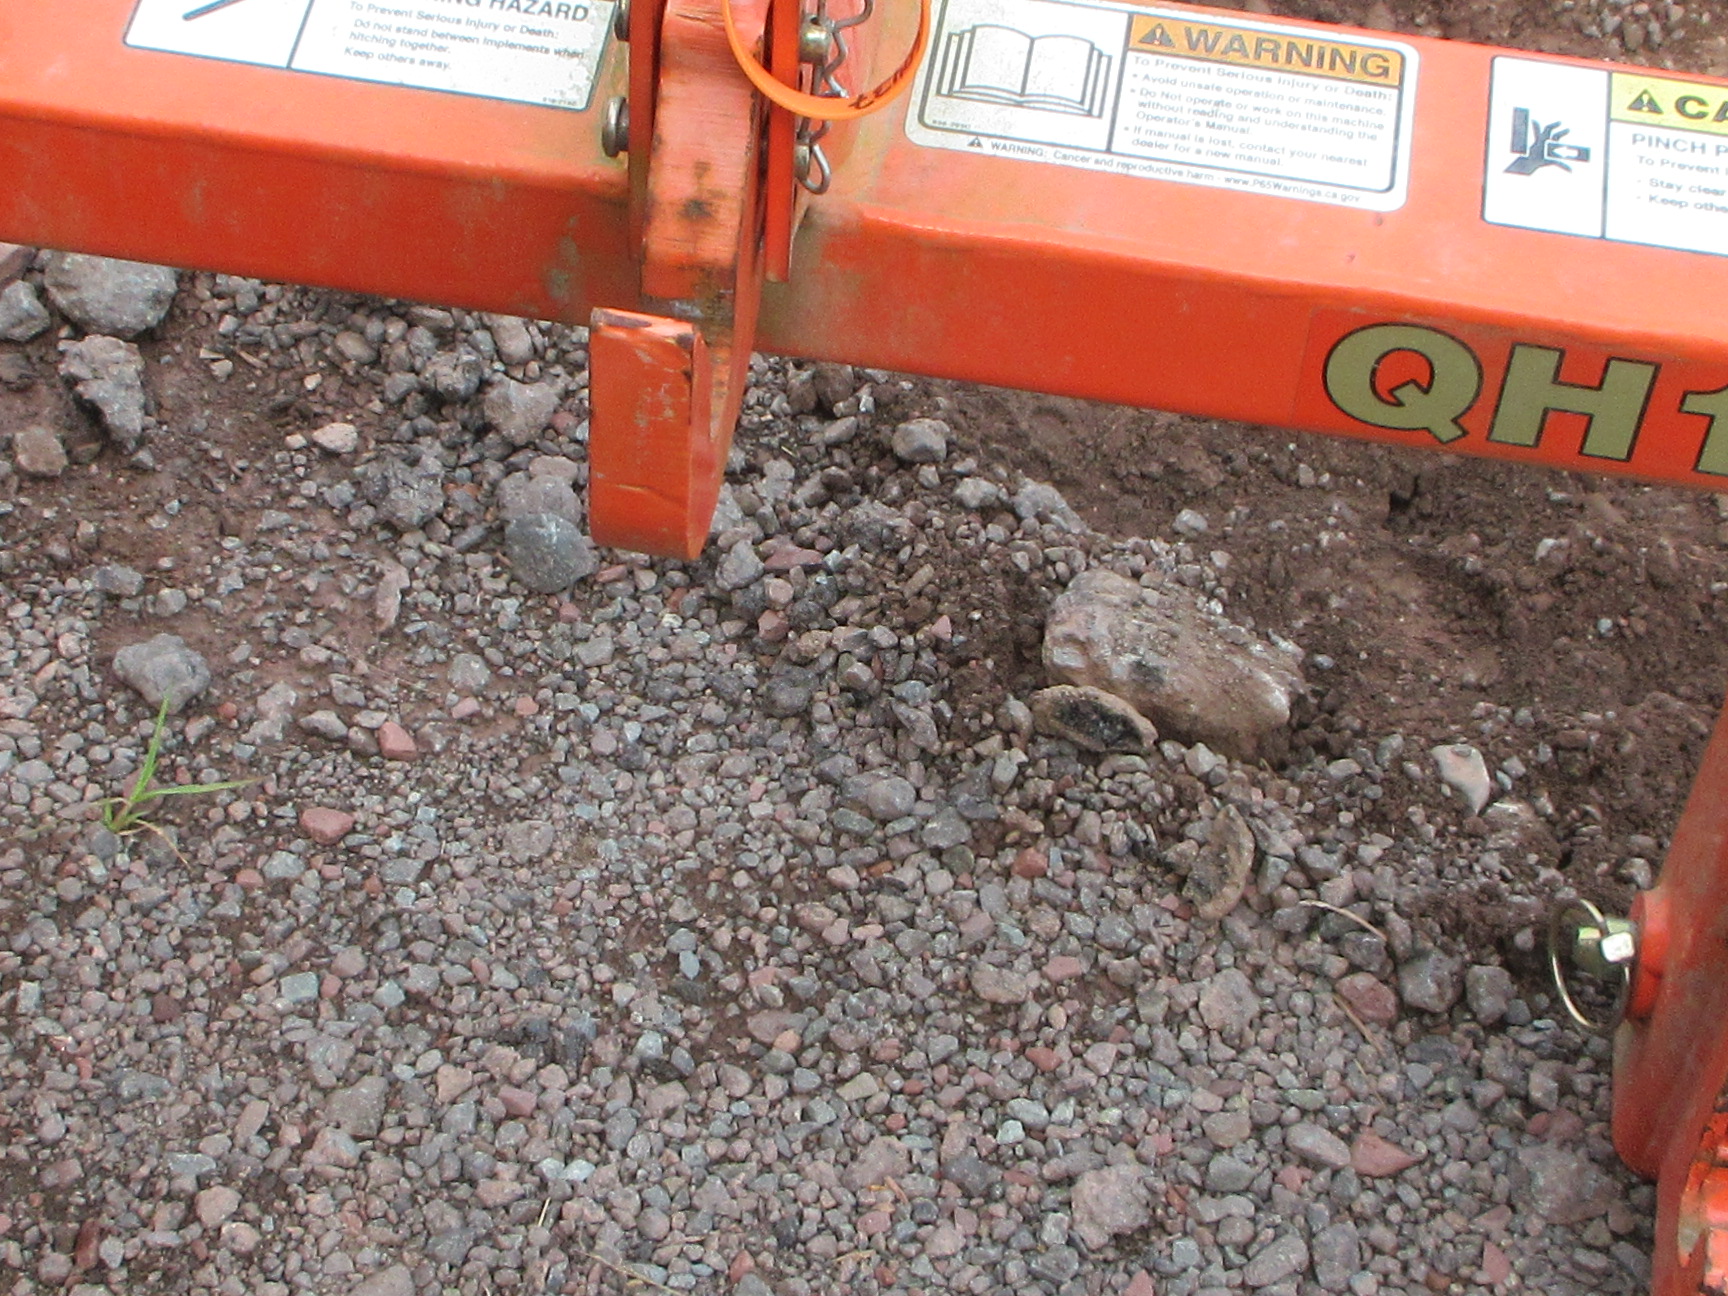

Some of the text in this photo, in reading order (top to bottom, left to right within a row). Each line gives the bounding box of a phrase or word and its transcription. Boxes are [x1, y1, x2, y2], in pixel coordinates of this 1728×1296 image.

[350, 0, 560, 39] To Prevent Serious Injury or Death:
[354, 18, 370, 28] Do
[373, 22, 392, 32] not
[395, 25, 428, 38] stand
[431, 29, 479, 45] between
[554, 46, 585, 59] when
[344, 46, 452, 71] Keep others away.
[349, 31, 451, 54] hitching together.
[1183, 26, 1391, 79] WARNING
[1134, 55, 1392, 101] To Prevent Serious Injury or Death:
[1142, 74, 1387, 116] Avoid unsafe operation or maintenance.
[1138, 99, 1378, 141] without reading and understanding the
[1139, 87, 1385, 130] Do Not operate or work on this machine
[1132, 138, 1284, 166] dealer for a new manual.
[1133, 125, 1142, 135] If
[1145, 128, 1191, 141] manual
[1194, 134, 1205, 143] is
[1239, 142, 1286, 155] contact
[1289, 149, 1317, 159] your
[1321, 153, 1368, 167] nearest
[1632, 133, 1707, 155] PINCH
[991, 141, 1361, 203] WARNING: Cancer and reproductive harm www.P65Warnings.ca.gov
[1637, 155, 1655, 166] To
[1660, 159, 1720, 175] Prevent
[1648, 178, 1683, 193] Stay
[1688, 184, 1727, 197] clear
[1648, 194, 1689, 209] Keep
